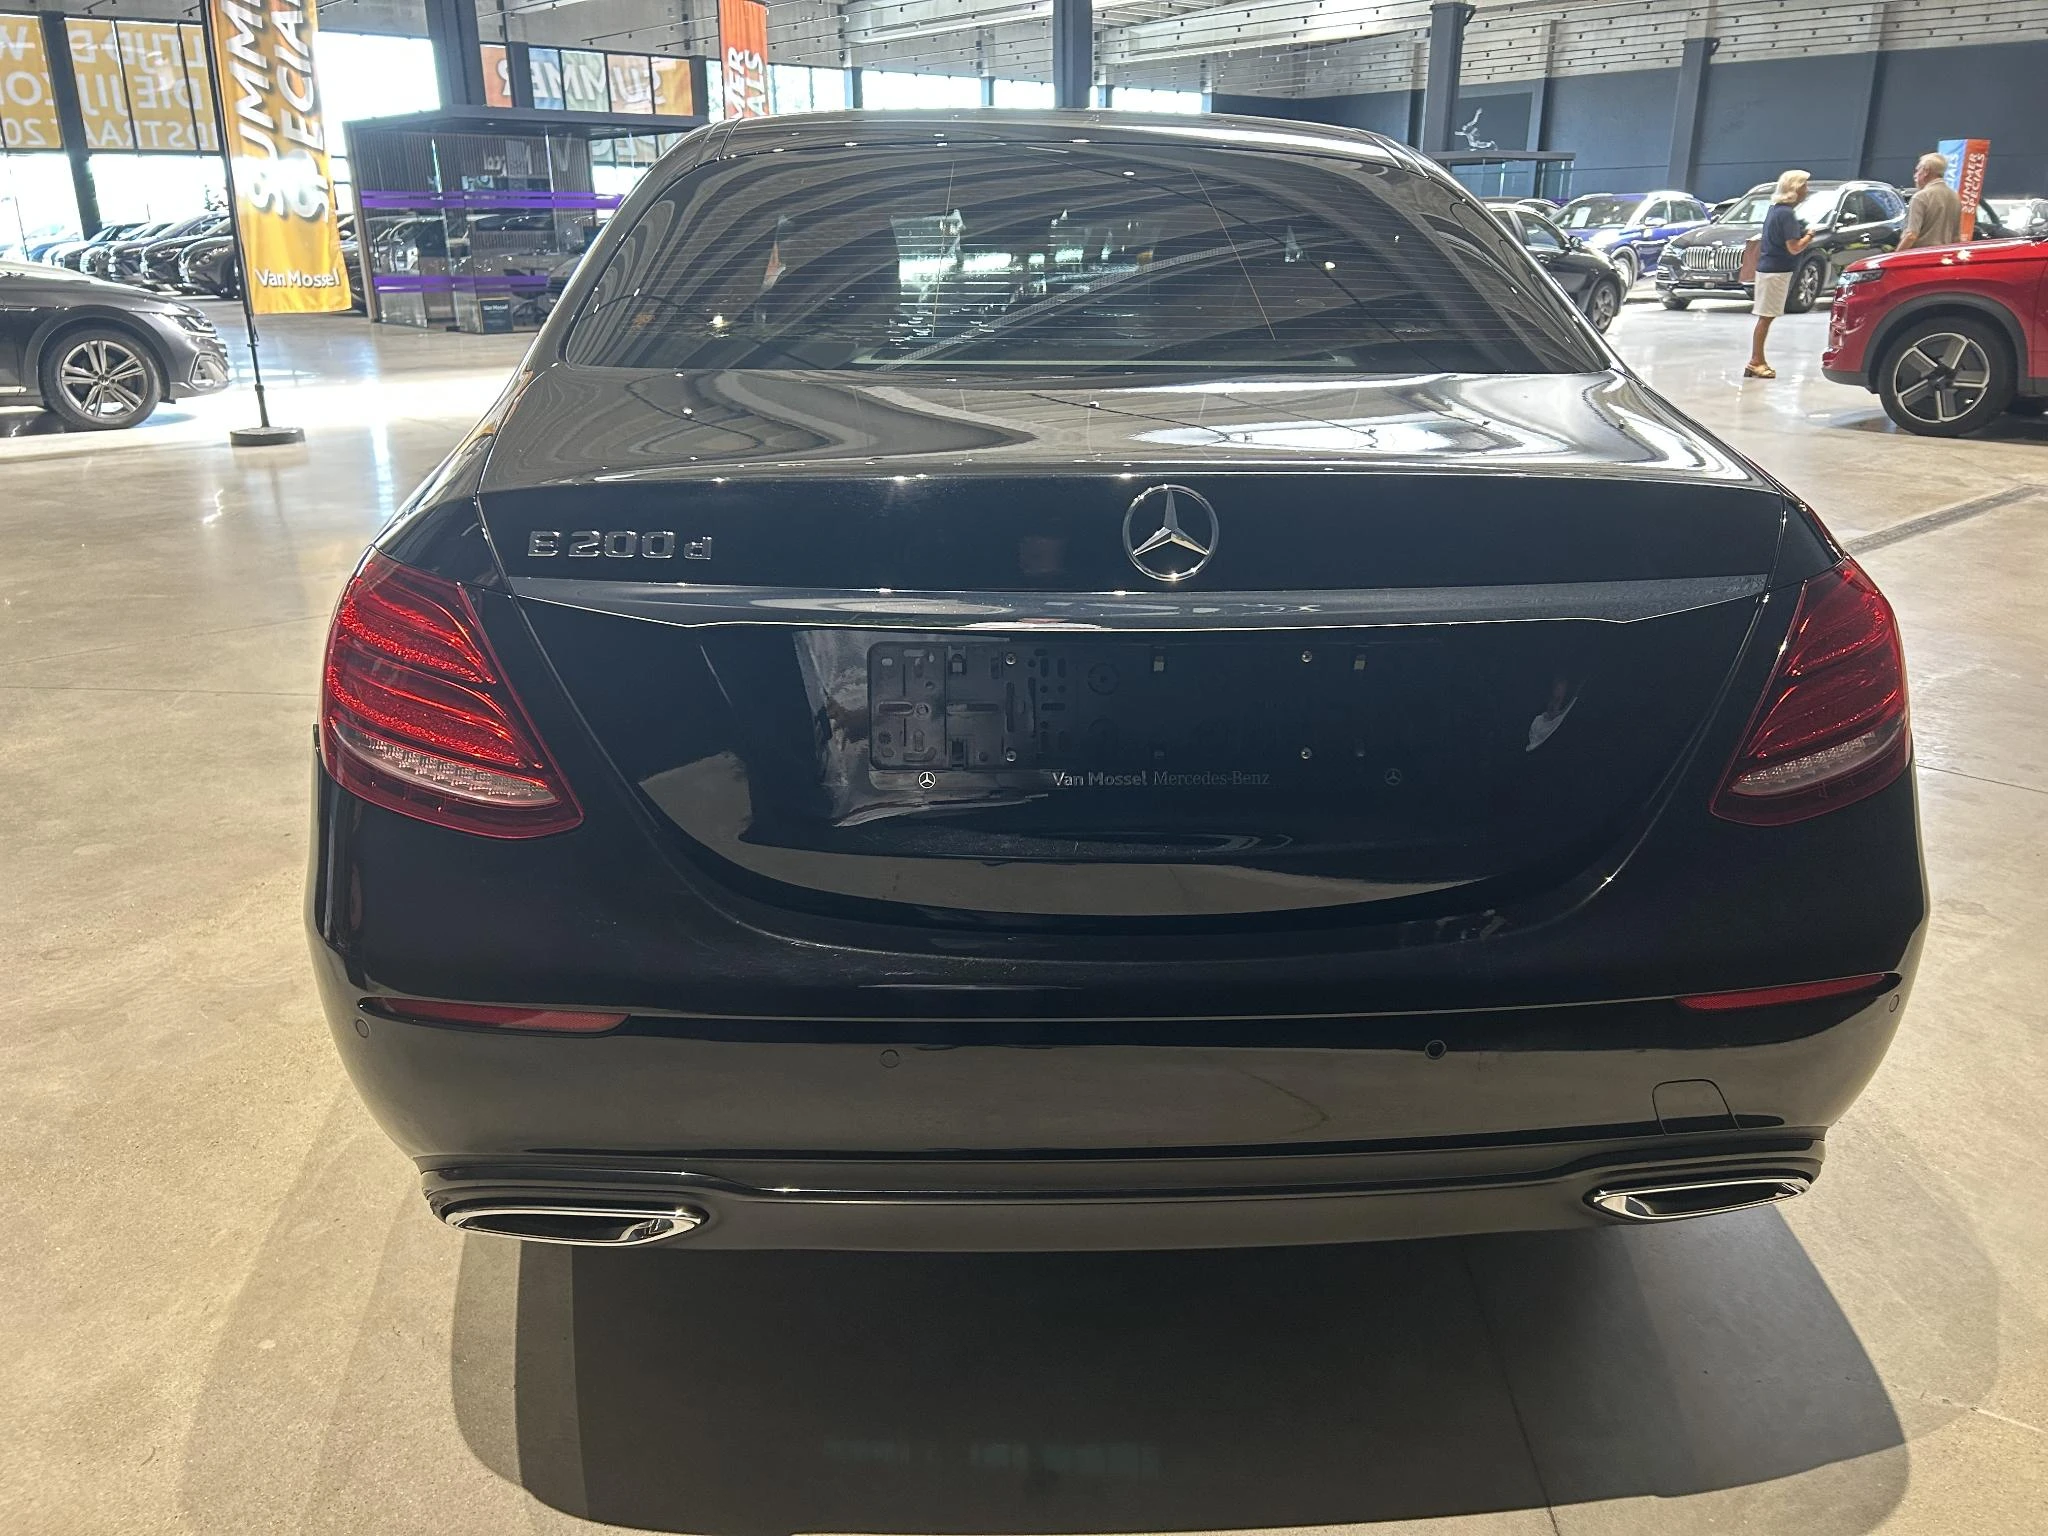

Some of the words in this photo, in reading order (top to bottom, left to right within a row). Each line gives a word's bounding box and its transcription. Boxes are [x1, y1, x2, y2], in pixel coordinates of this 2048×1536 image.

[220, 0, 284, 216] SUMM
[271, 0, 330, 223] SPECIA
[745, 49, 766, 115] ALS
[1961, 153, 1978, 213] SUMMER
[1968, 153, 1985, 214] SPECIALS
[255, 268, 287, 287] Van
[288, 267, 340, 288] Mossel
[528, 531, 561, 556] E
[568, 531, 675, 559] 200
[1052, 771, 1084, 786] Van
[1088, 770, 1147, 786] Mossel
[1153, 771, 1270, 786] Mercedes-Benz
